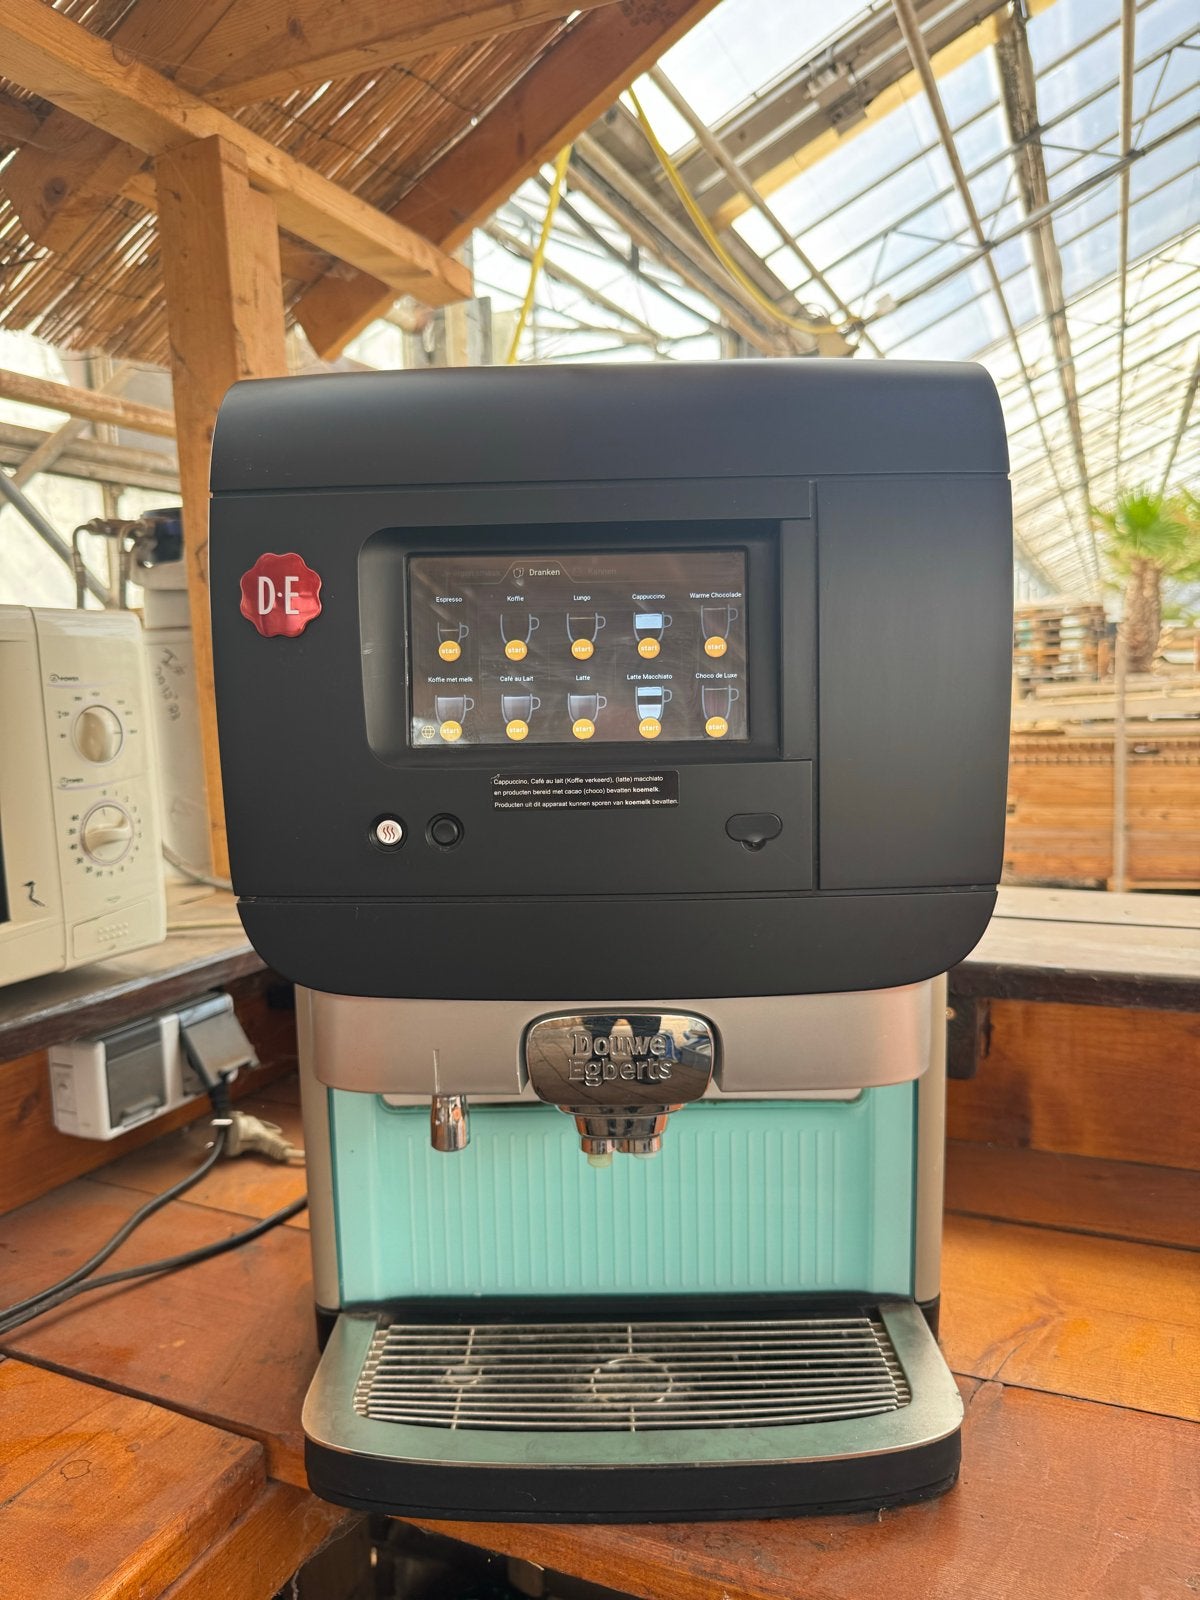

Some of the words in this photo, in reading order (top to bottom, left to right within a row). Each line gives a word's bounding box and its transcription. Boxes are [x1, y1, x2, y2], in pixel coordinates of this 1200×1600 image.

[529, 568, 561, 576] Dranken
[564, 777, 584, 785] (Koffie
[502, 789, 532, 797] producten
[583, 787, 606, 795] (choco)
[571, 1031, 667, 1056] Douwe
[568, 1057, 673, 1087] Egberts
